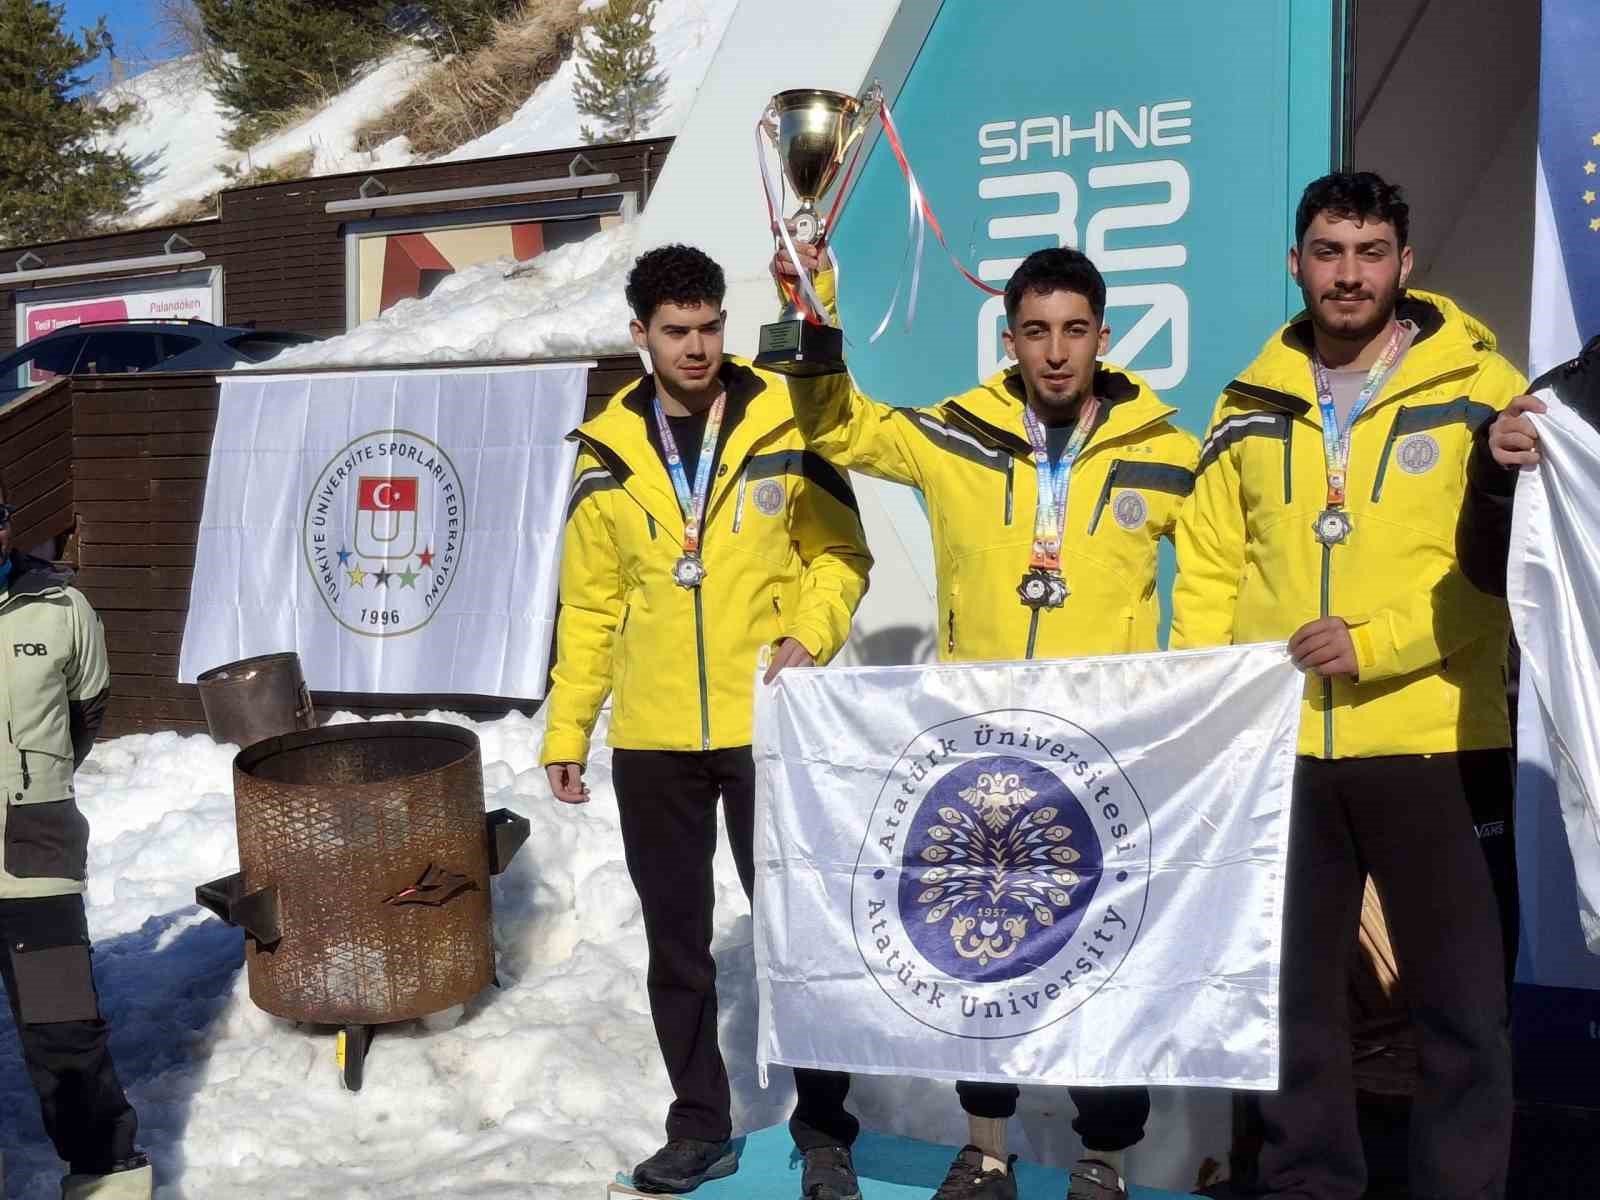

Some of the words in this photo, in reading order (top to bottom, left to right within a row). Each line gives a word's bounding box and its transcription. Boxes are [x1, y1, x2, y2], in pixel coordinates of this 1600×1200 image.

[978, 100, 1192, 165] SAHNE
[978, 159, 1191, 281] 32
[313, 445, 374, 527] ÜNİVERSİTE
[378, 442, 445, 484] SPORLARI
[424, 483, 458, 608] FEDERASYONU
[13, 643, 48, 657] FOB
[360, 608, 400, 626] 1996
[879, 738, 958, 854] Atatürk
[974, 724, 1136, 854] Üniversitesi
[867, 899, 945, 1008] Atatürk
[961, 904, 1127, 1018] University
[976, 907, 1008, 918] 1957
